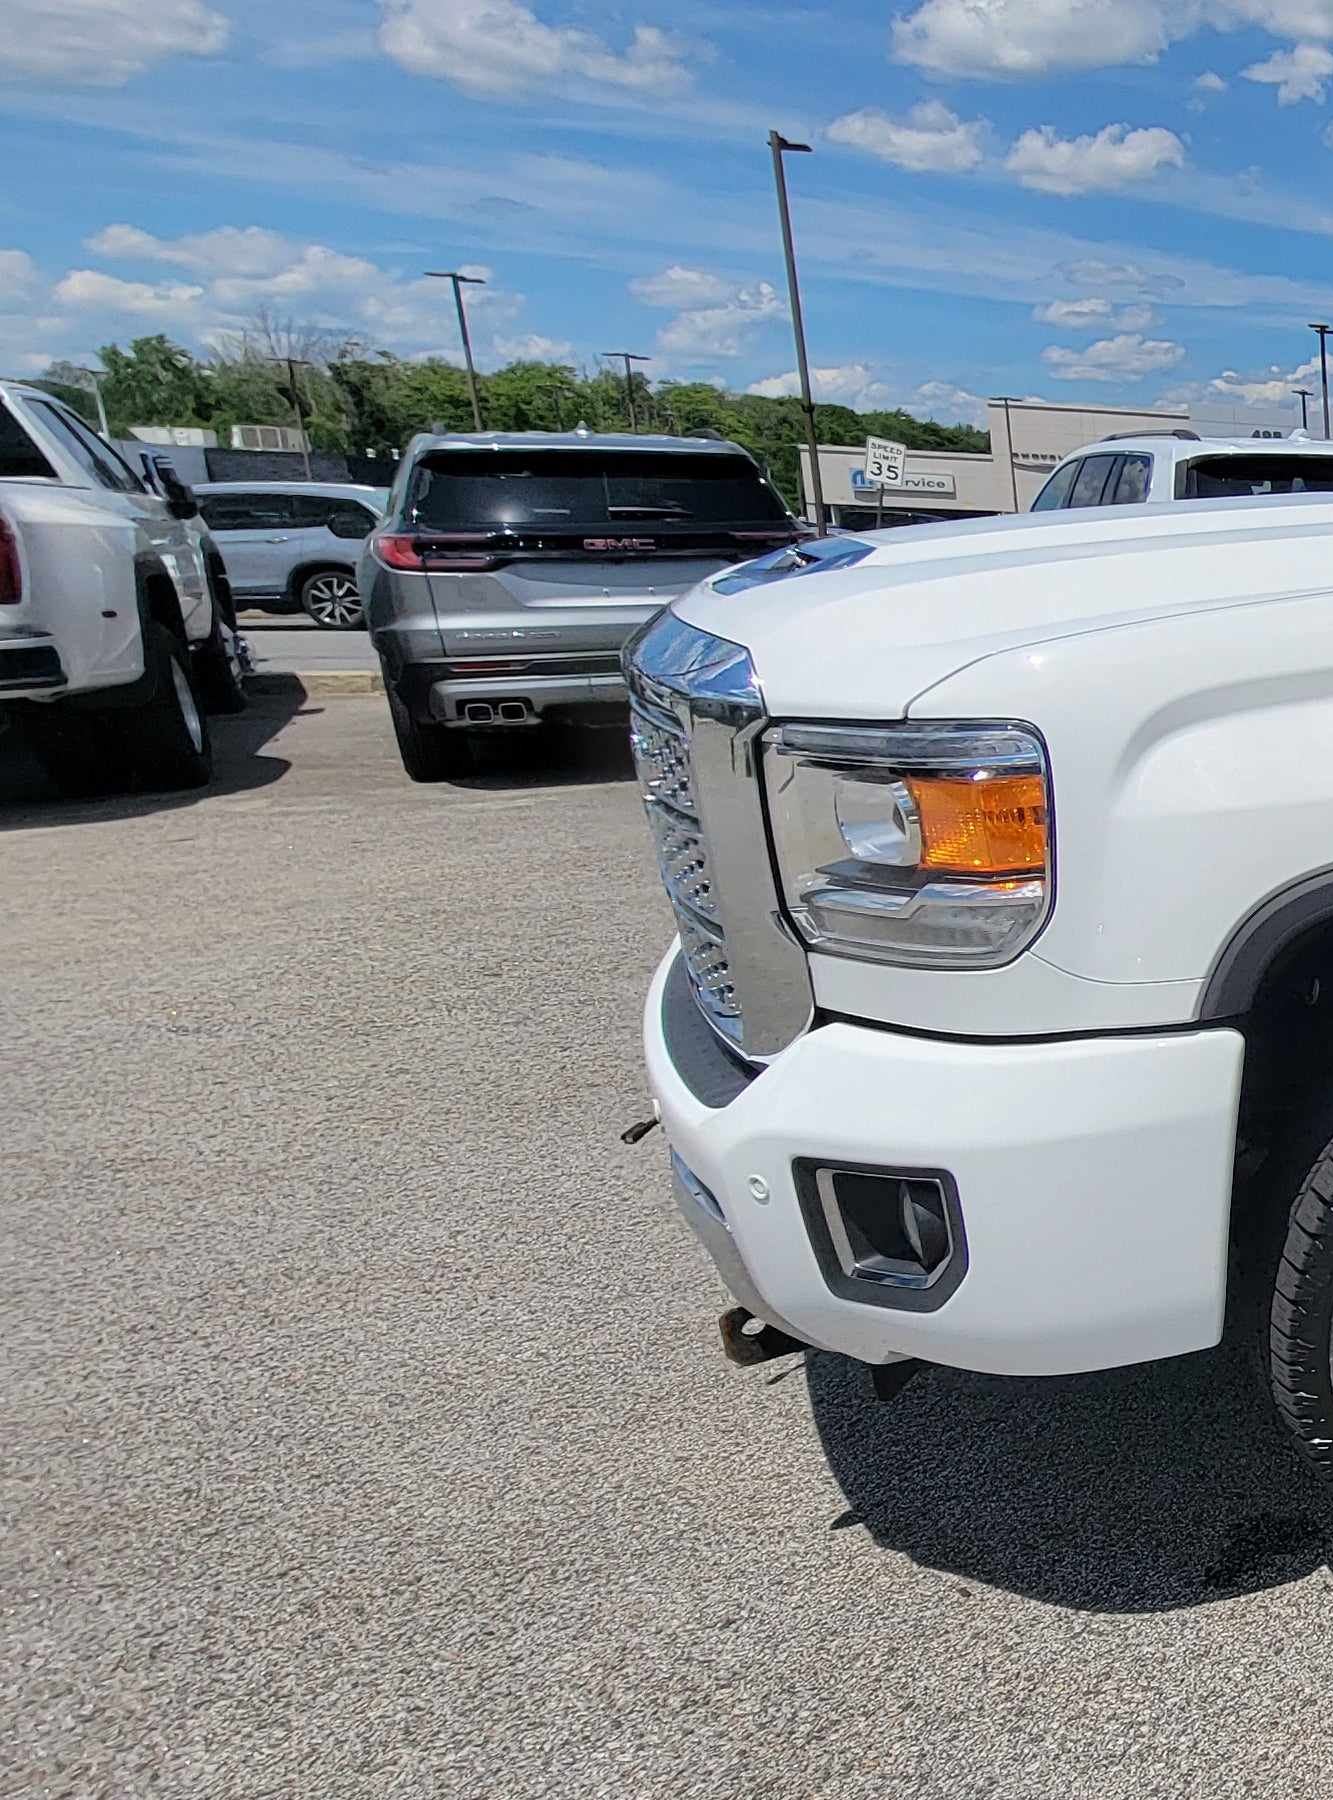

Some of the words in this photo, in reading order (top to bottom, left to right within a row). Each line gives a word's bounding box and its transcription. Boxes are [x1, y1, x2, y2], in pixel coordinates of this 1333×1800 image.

[870, 442, 903, 456] SPEED
[873, 452, 898, 463] LIMIT
[870, 461, 899, 480] 35
[905, 478, 946, 489] rvice
[583, 538, 656, 550] GMC
